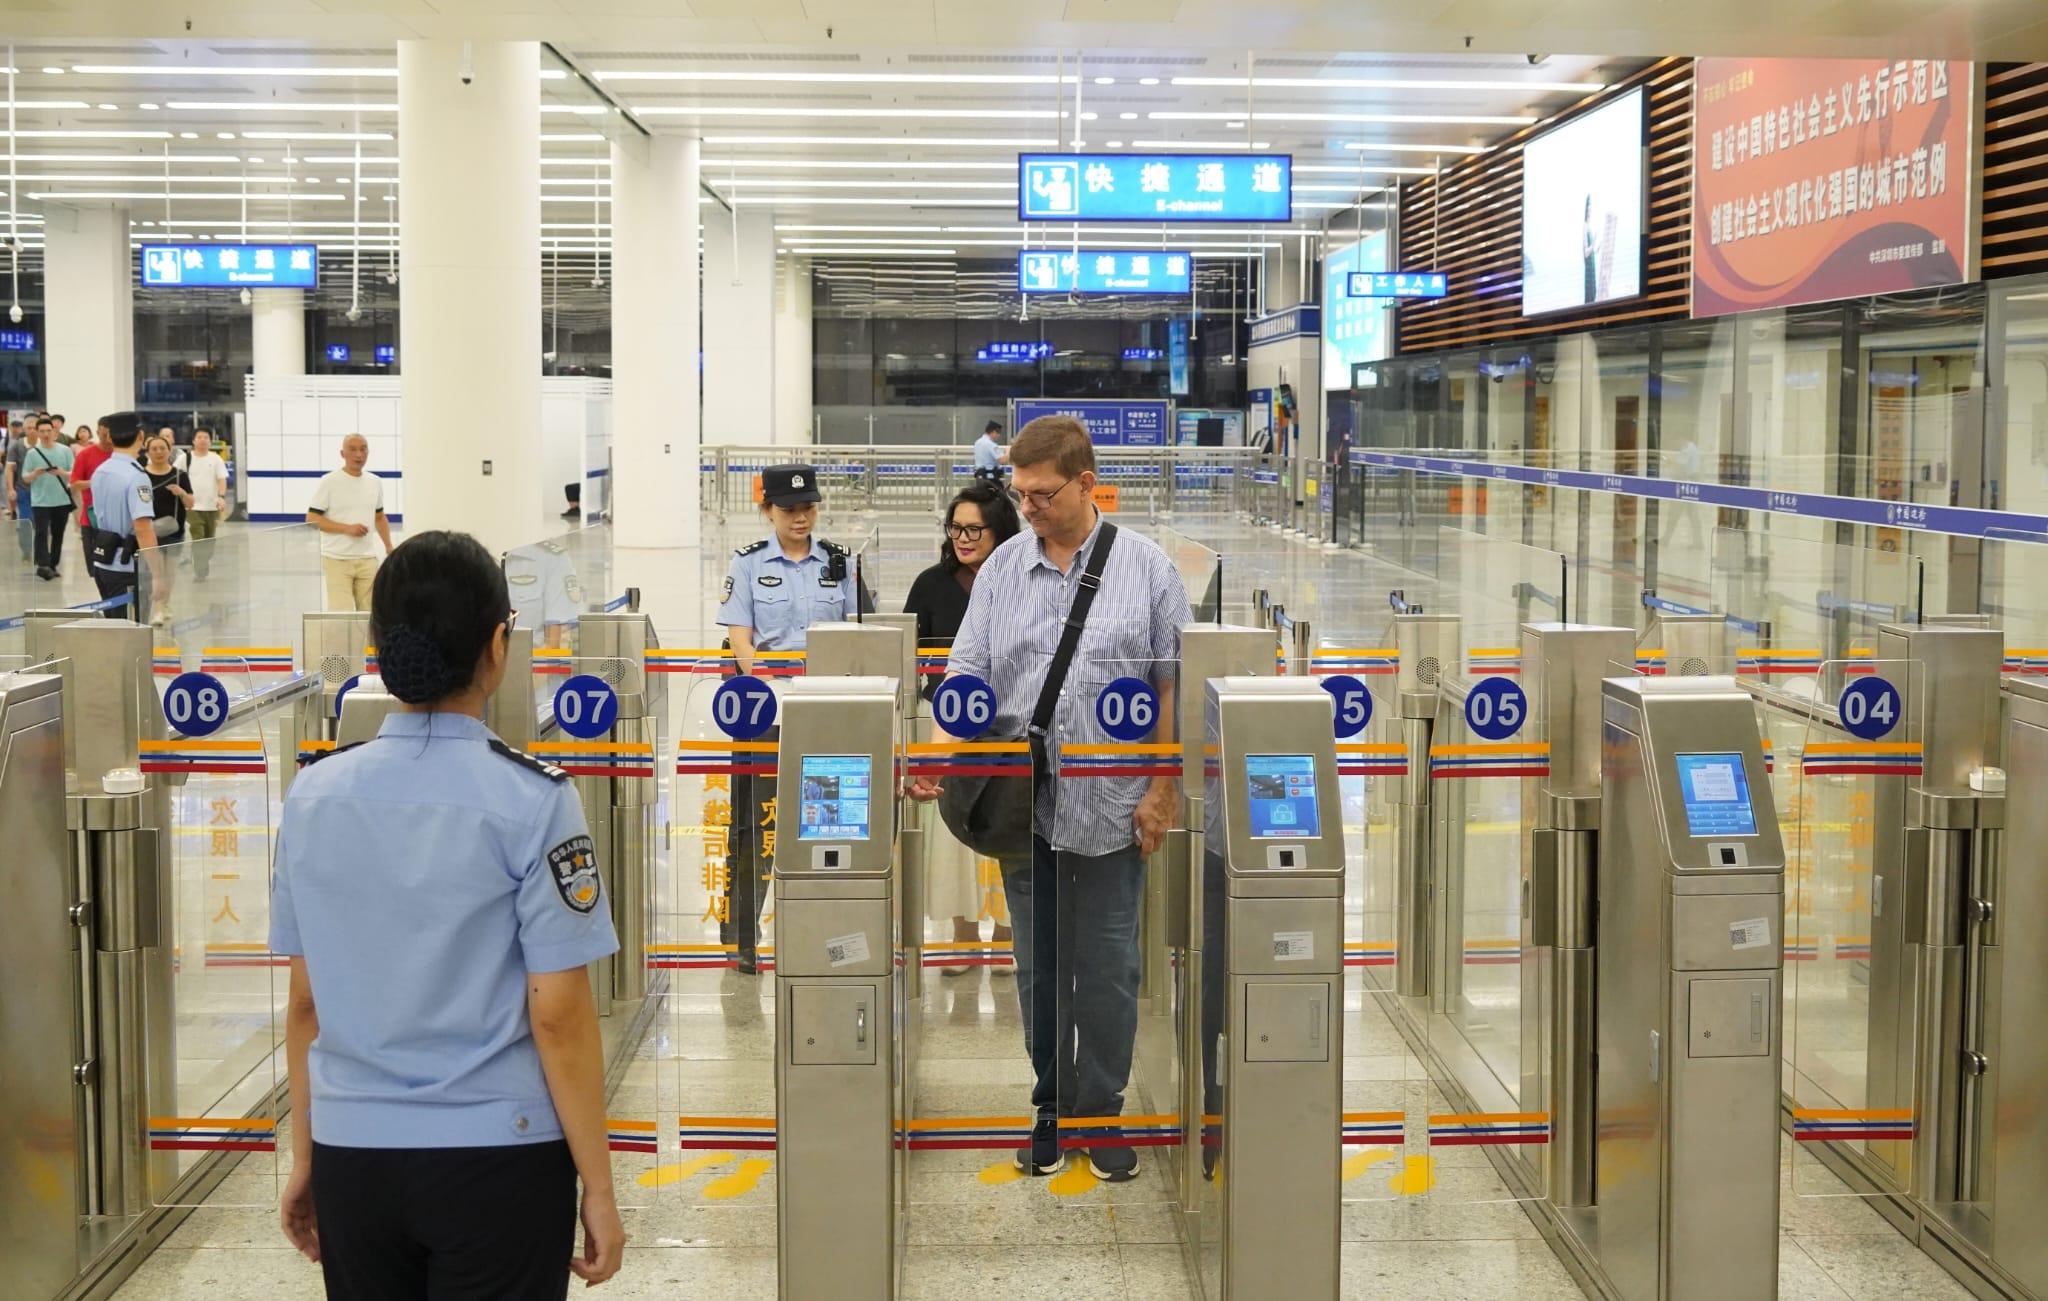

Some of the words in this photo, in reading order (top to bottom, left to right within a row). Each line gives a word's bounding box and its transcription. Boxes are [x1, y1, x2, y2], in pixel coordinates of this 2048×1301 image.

[1085, 163, 1282, 193] 快捷通道
[1710, 142, 1947, 245] 创建社会主义现代化强国的城市范例
[1156, 200, 1223, 212] E-channel
[183, 249, 311, 270] 快捷通道
[1061, 255, 1186, 275] 快捷通道
[169, 688, 220, 722] 08
[560, 690, 610, 723] 07
[719, 691, 769, 724] 07
[937, 690, 989, 723] 06
[1102, 693, 1153, 725] 06
[1471, 693, 1520, 726] 05
[1845, 692, 1894, 724] 04
